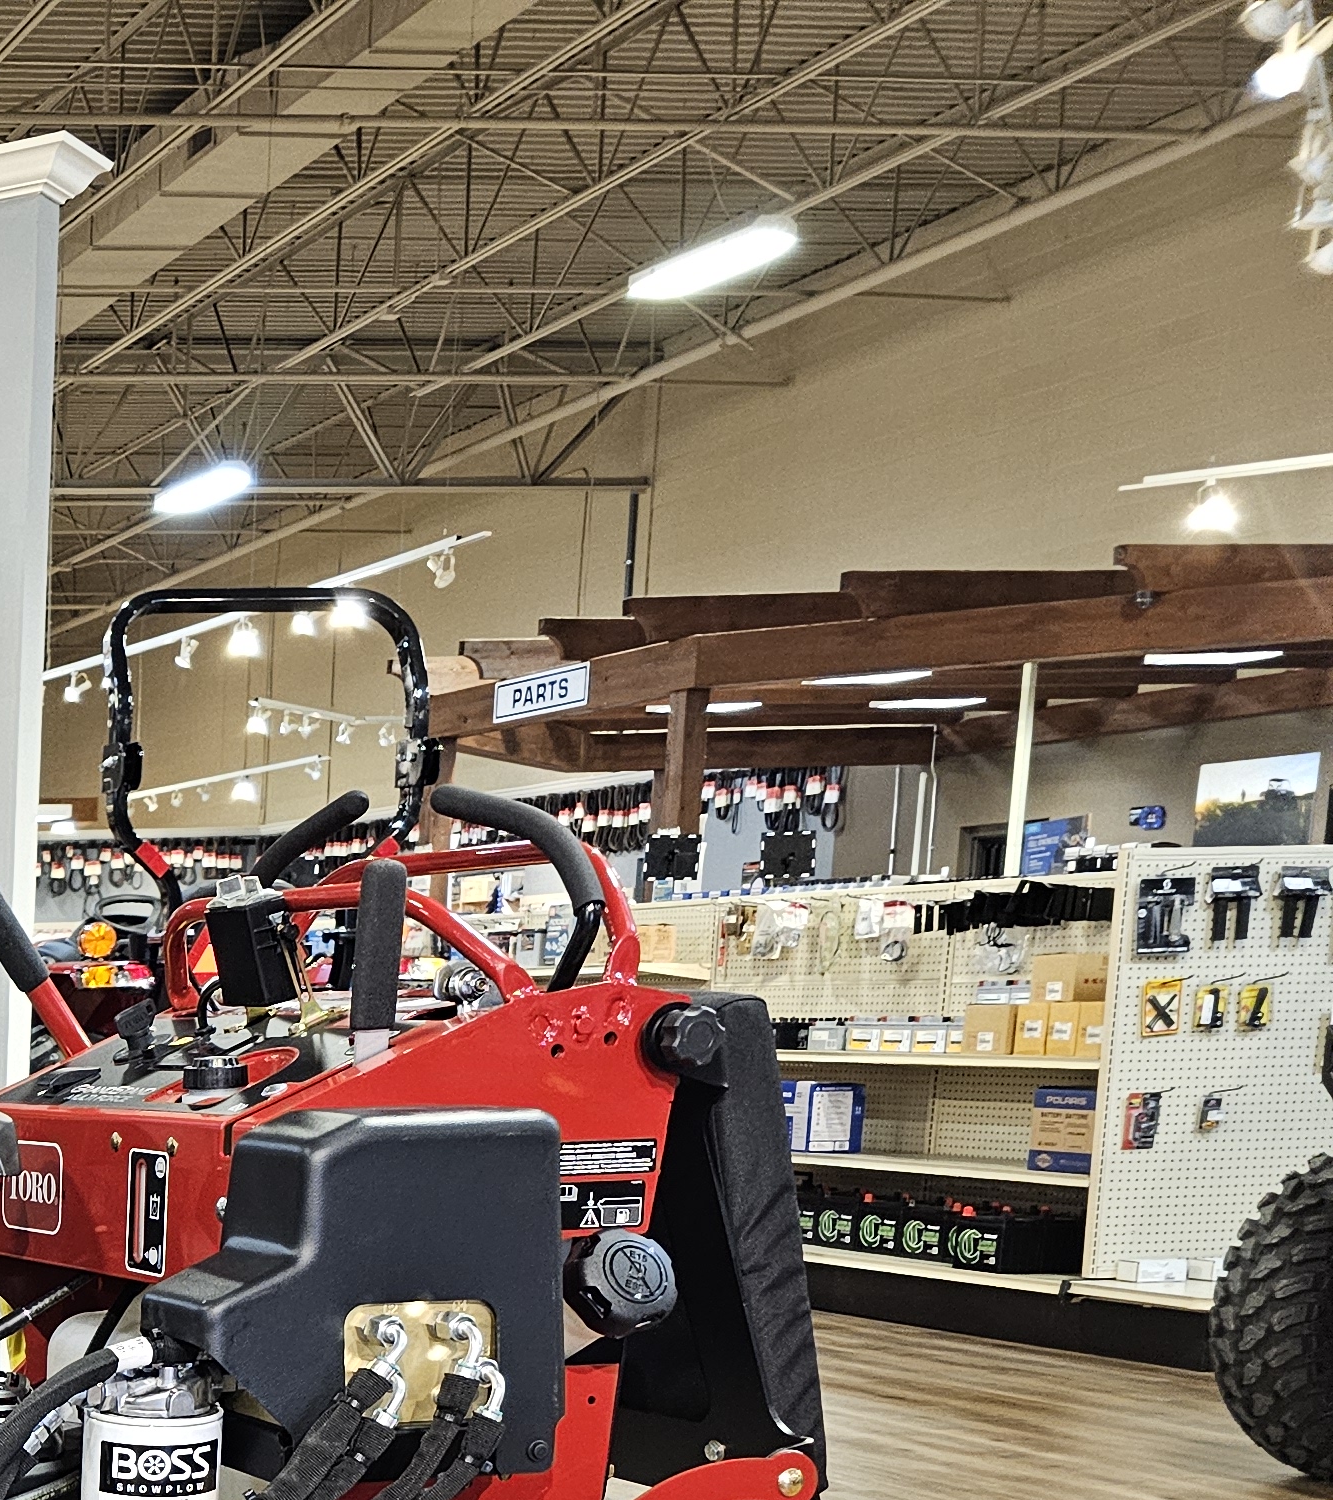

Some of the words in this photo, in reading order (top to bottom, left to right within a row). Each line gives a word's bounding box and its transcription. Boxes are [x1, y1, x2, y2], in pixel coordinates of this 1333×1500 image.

[512, 677, 569, 709] PARTS
[1045, 1095, 1088, 1106] POLARIS
[111, 1444, 212, 1482] BOSS
[116, 1481, 205, 1494] SNOWPLOW
